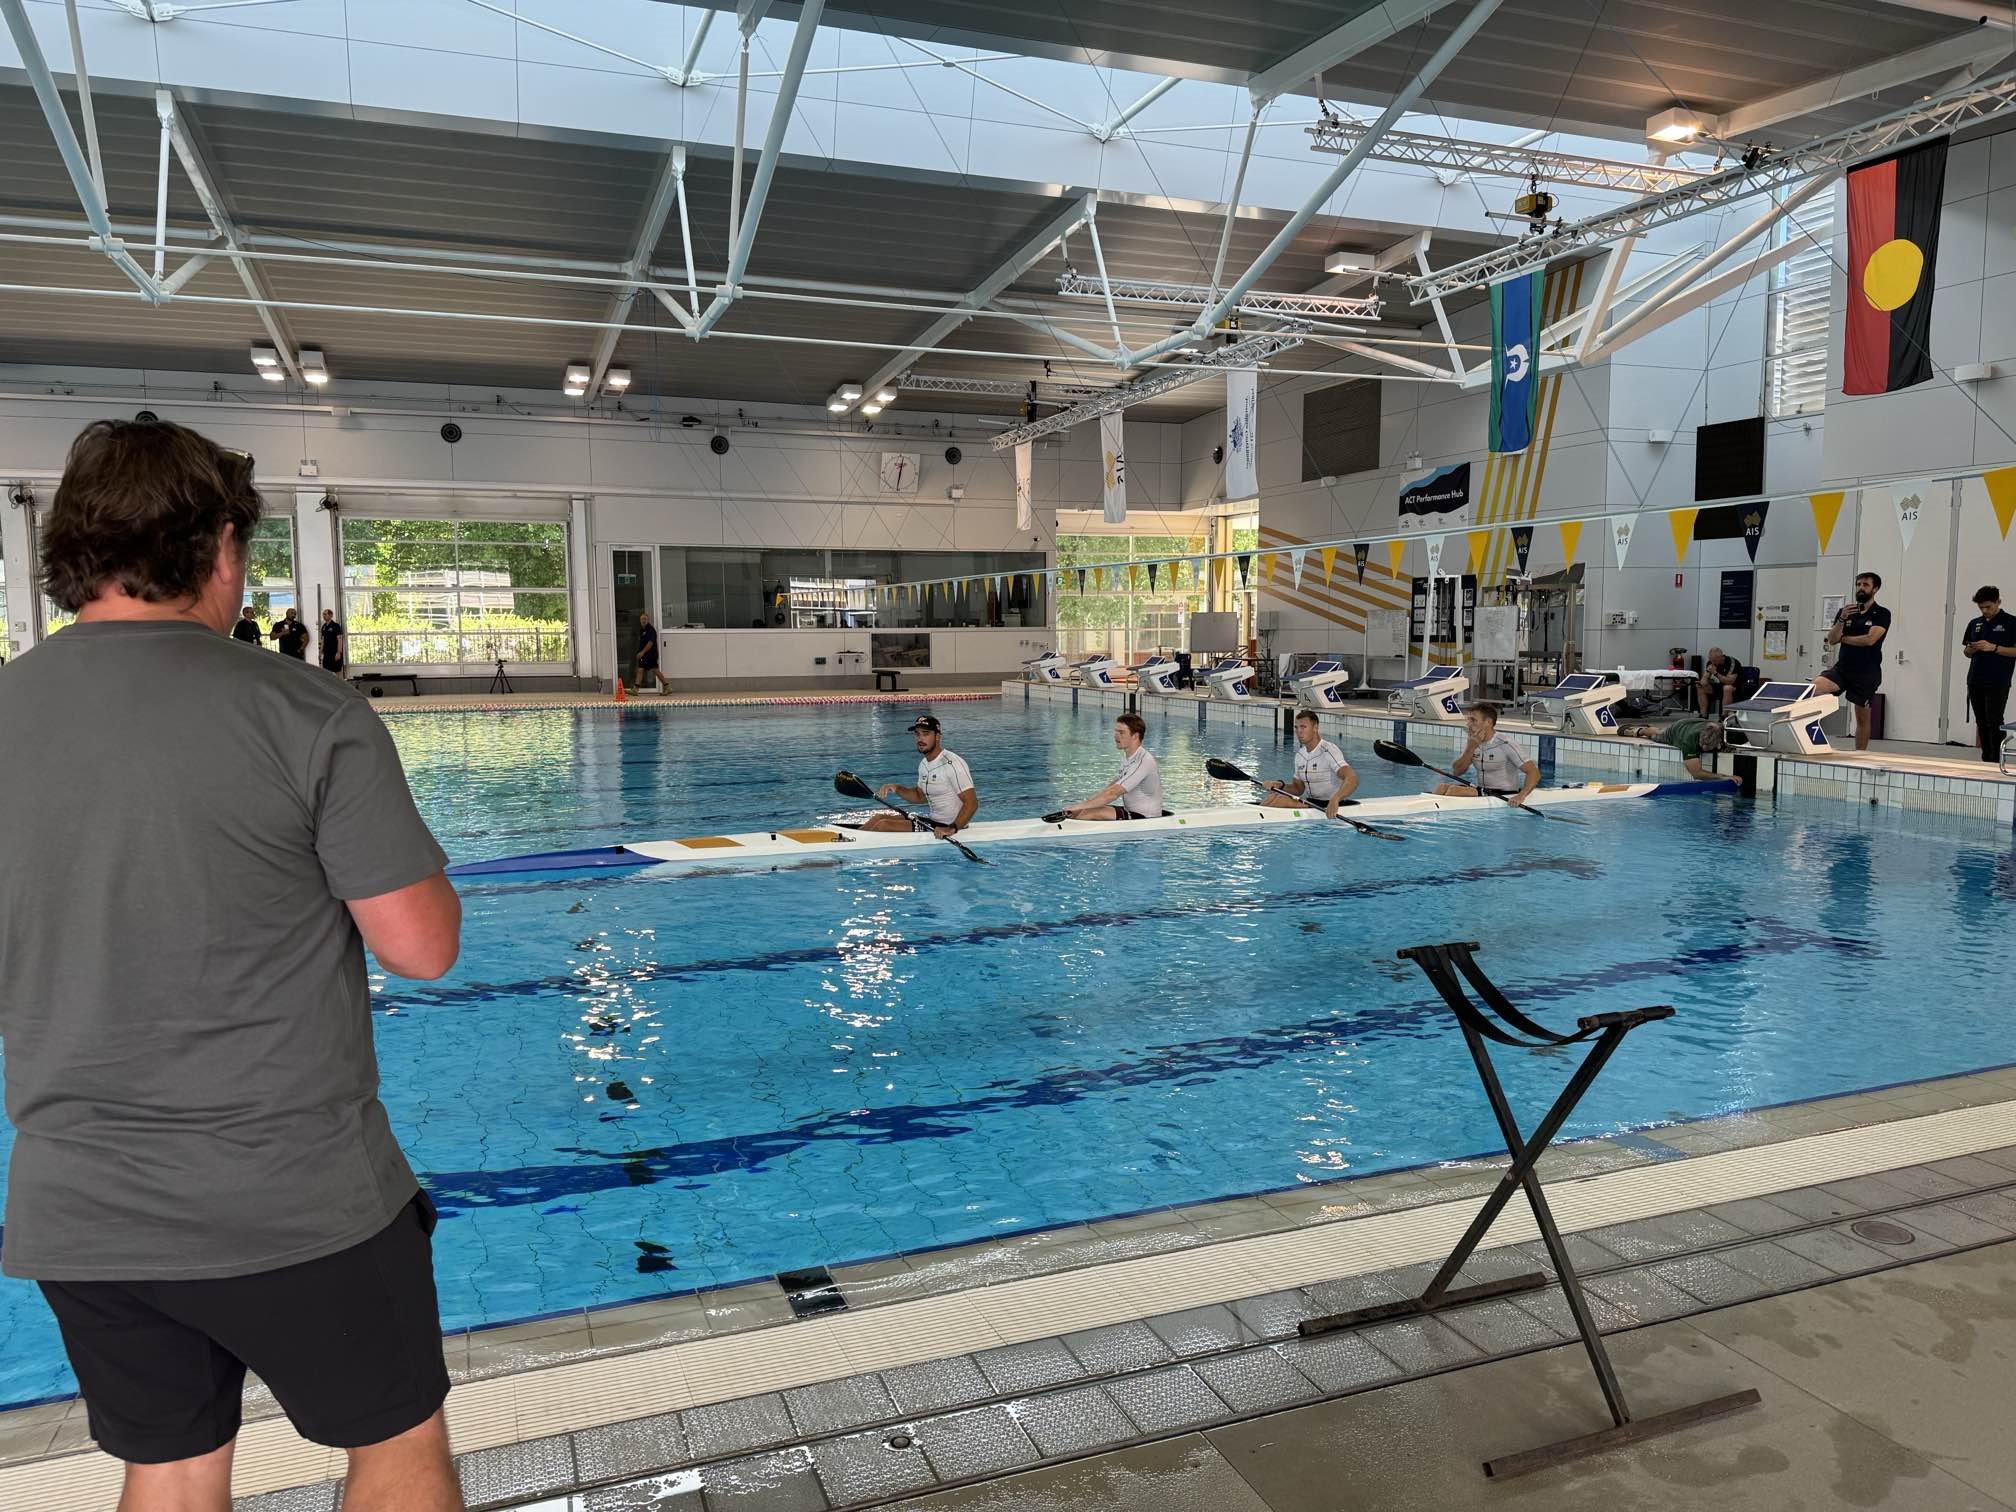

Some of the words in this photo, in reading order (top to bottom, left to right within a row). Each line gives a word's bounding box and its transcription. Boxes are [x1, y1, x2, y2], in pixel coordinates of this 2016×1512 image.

[1404, 495, 1416, 505] ACT
[1416, 492, 1450, 503] Performance
[1451, 488, 1464, 499] Hub
[1901, 511, 1918, 520] AIS
[1745, 526, 1760, 536] AIS
[1617, 537, 1629, 545] AIS
[1163, 677, 1169, 687] 2
[1236, 684, 1242, 694] 3
[1328, 690, 1335, 700] 4
[1446, 700, 1453, 711] 5
[1601, 711, 1608, 723] 6
[1811, 726, 1820, 741] 7
